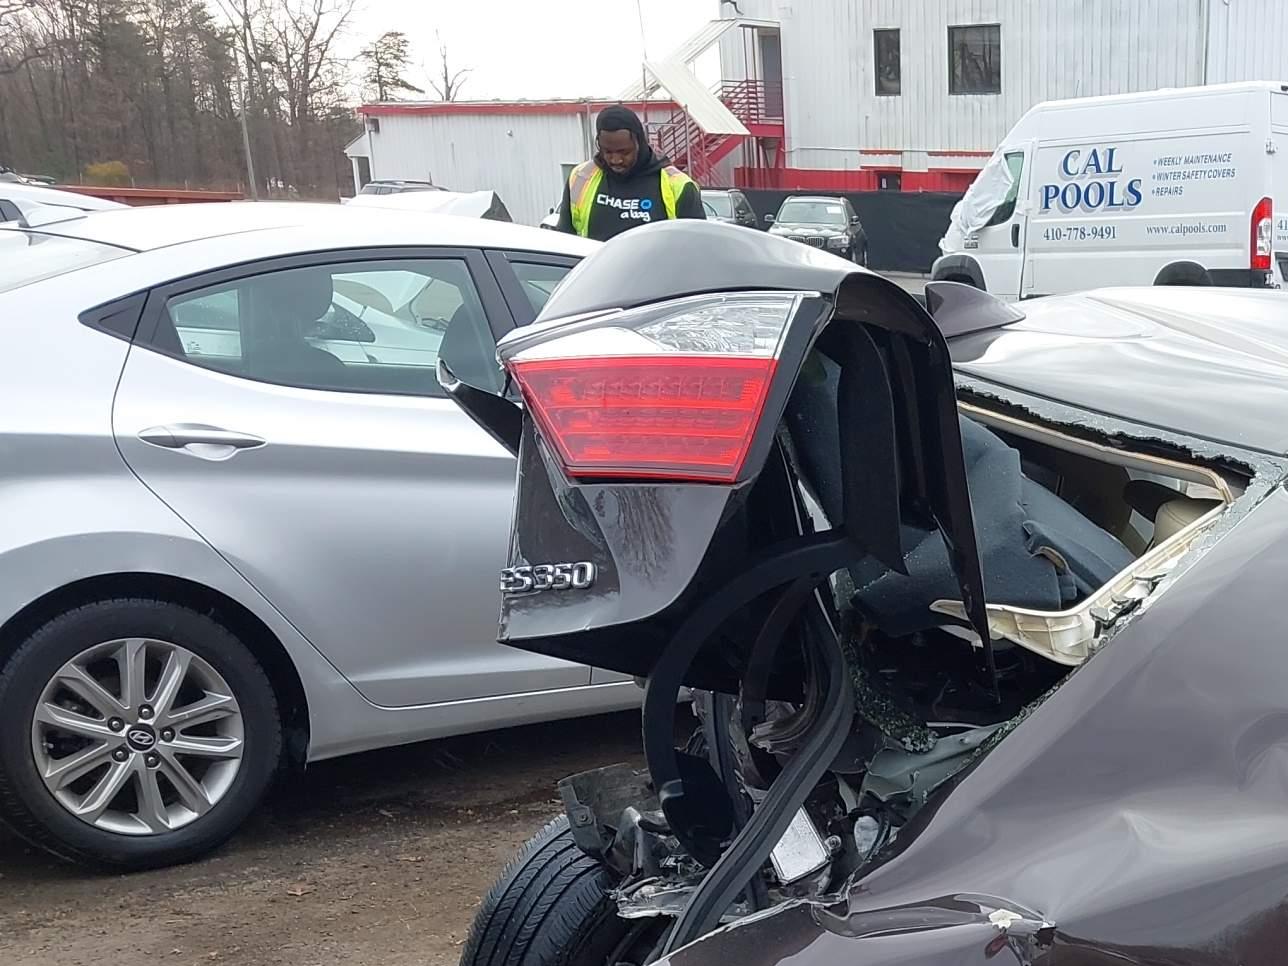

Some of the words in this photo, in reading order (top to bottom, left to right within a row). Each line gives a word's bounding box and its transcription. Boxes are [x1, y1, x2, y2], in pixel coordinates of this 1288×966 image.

[1061, 147, 1122, 176] CAL
[1157, 157, 1182, 166] WEEKLY
[1184, 153, 1232, 164] MAINTENANCE
[1156, 171, 1180, 180] WINTER
[1181, 169, 1208, 180] SAFETY
[1207, 168, 1236, 179] COVERS
[1041, 178, 1143, 210] POOLS
[1155, 186, 1183, 196] REPAIRS
[597, 194, 639, 209] CHASE
[1043, 225, 1116, 241] 410-778-9491
[1146, 222, 1227, 237] www.calpools.com
